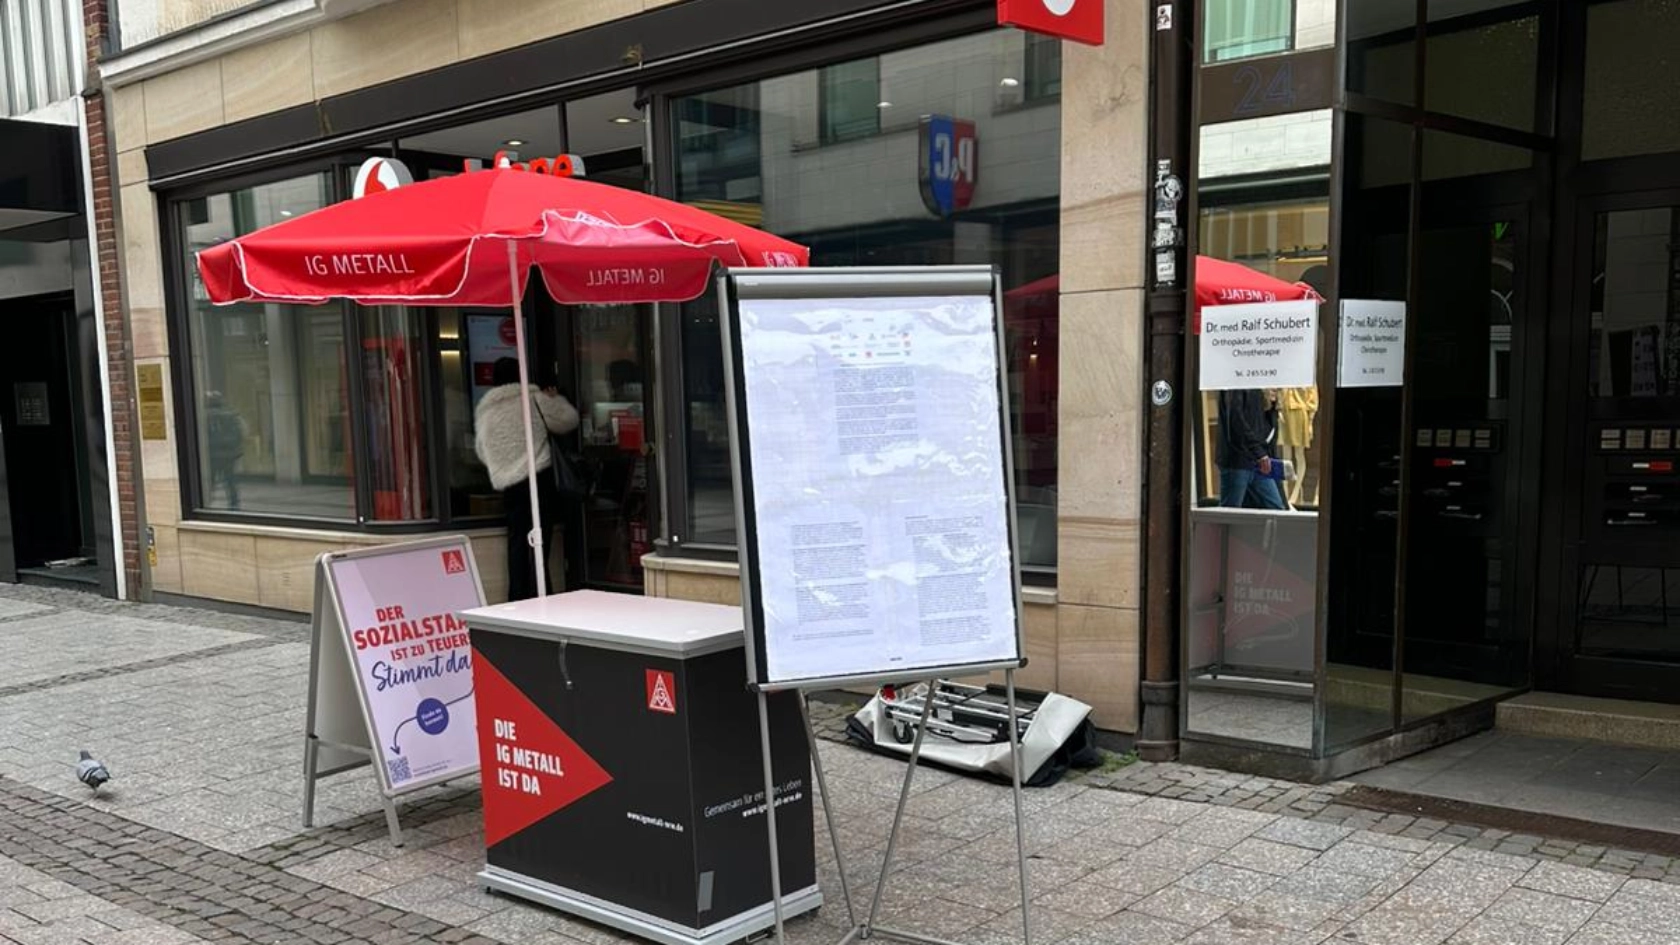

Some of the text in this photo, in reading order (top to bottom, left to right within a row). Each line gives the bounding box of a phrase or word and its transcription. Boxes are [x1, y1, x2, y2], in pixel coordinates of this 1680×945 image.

[1232, 61, 1297, 117] 24
[304, 253, 416, 276] IG METALL
[1241, 318, 1262, 331] Ralf
[1263, 316, 1311, 330] Schubert
[375, 605, 404, 623] DER
[391, 647, 408, 661] IST
[411, 644, 425, 657] ZU
[371, 650, 471, 692] Stimmt da
[494, 718, 517, 741] DIE
[496, 742, 565, 777] IG METALL
[498, 766, 542, 796] IST DA
[703, 797, 743, 818] Gemeinsam
